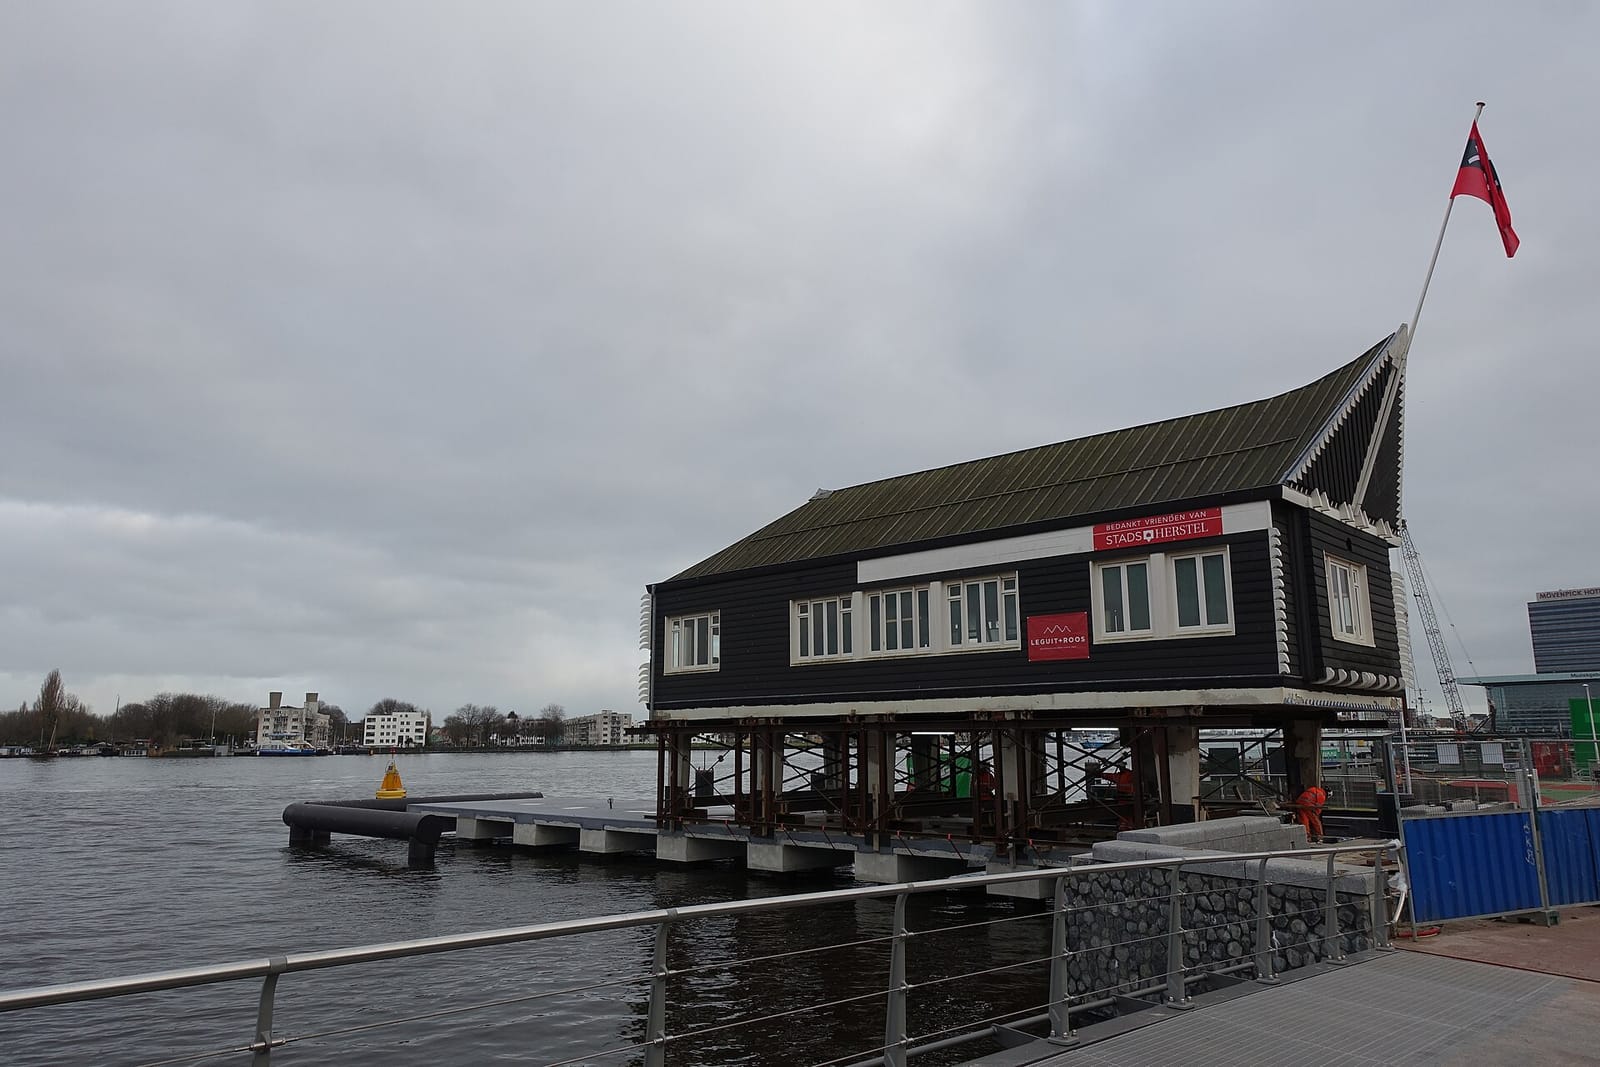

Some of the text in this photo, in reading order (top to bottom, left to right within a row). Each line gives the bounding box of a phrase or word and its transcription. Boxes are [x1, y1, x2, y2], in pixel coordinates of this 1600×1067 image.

[1106, 511, 1207, 531] BEDANKT VRIENDEN VAN
[1106, 522, 1209, 545] STADS HERSTEL
[1584, 588, 1600, 596] HOT
